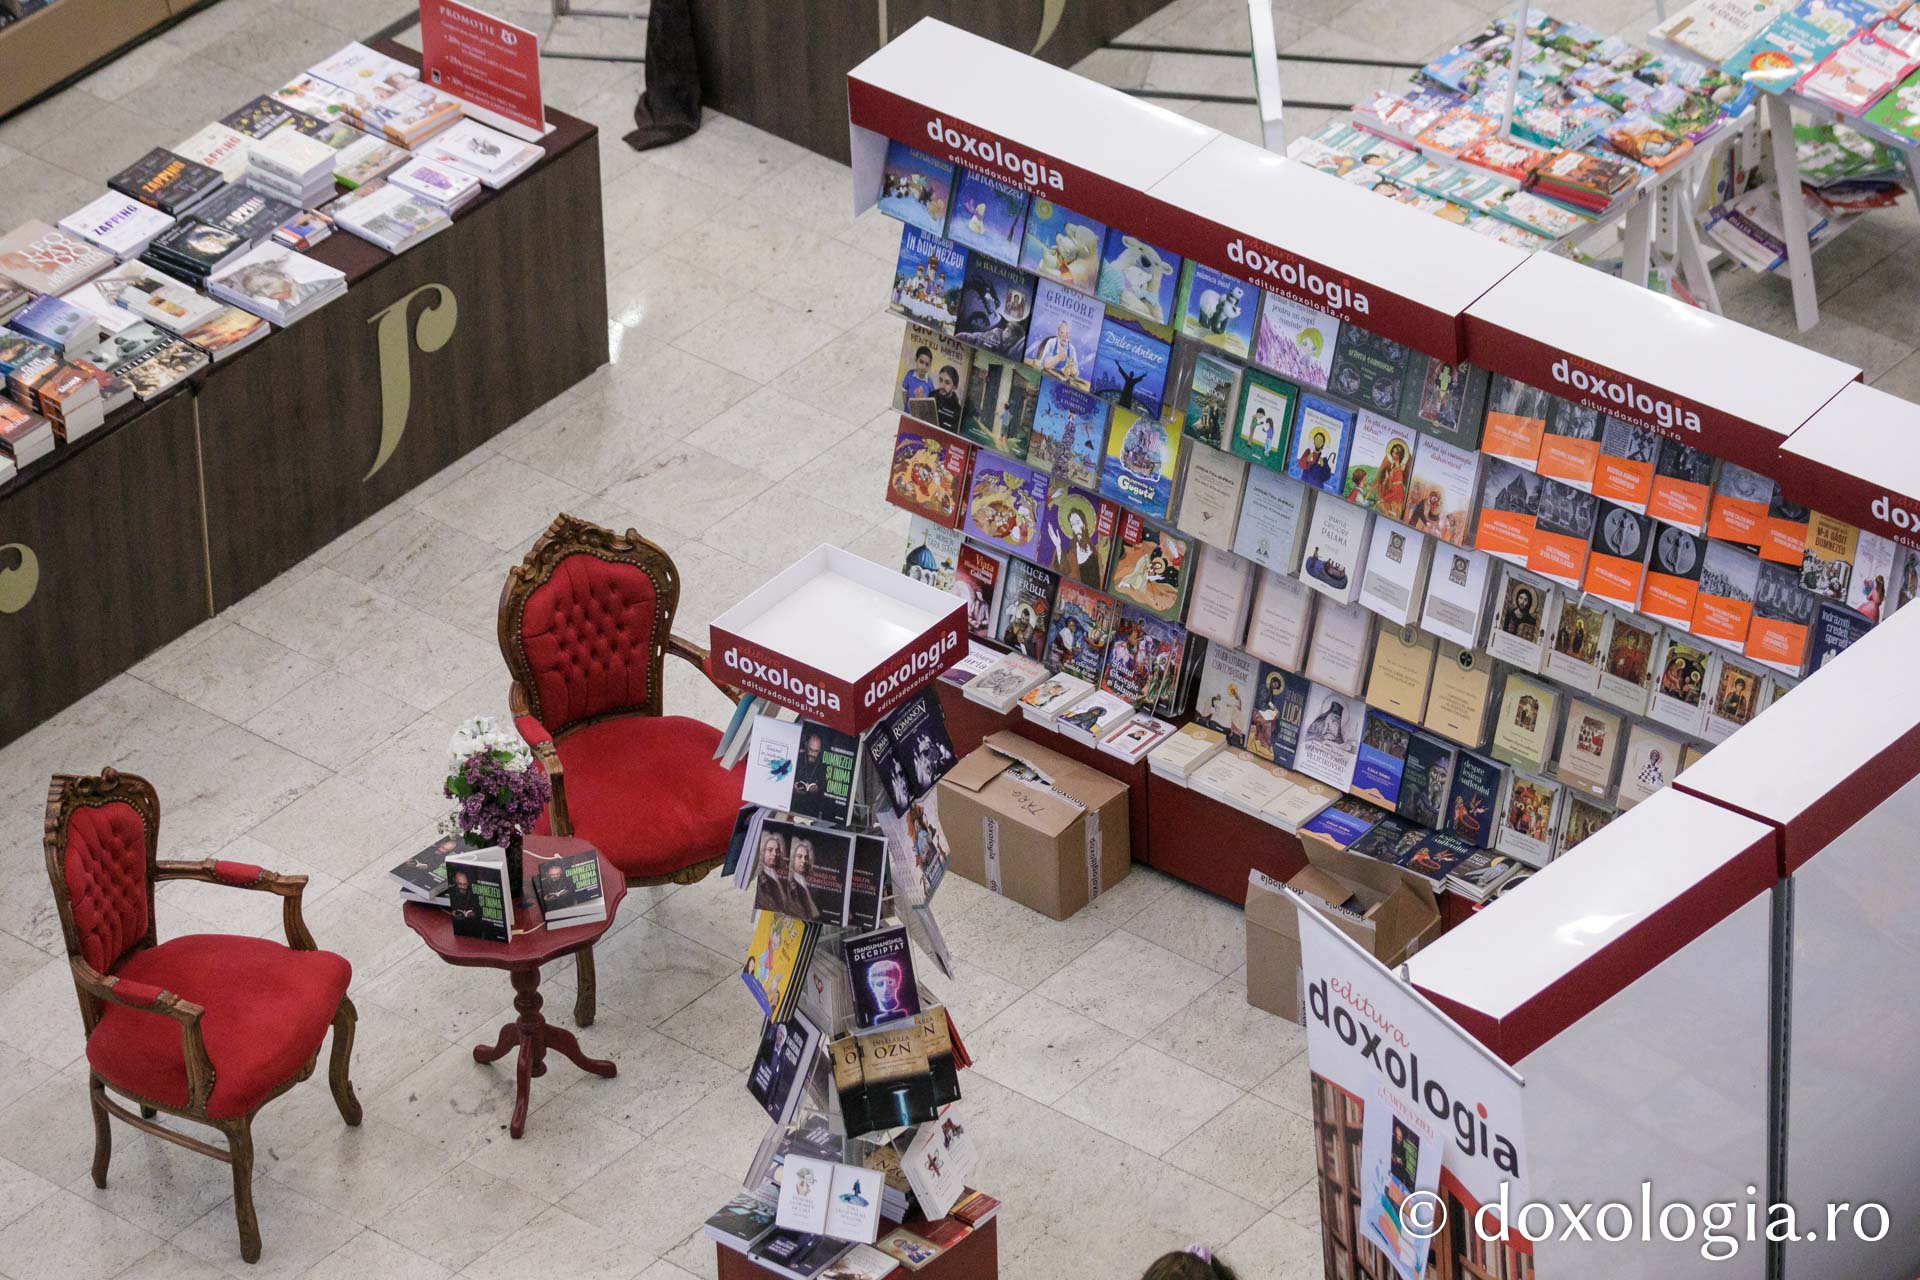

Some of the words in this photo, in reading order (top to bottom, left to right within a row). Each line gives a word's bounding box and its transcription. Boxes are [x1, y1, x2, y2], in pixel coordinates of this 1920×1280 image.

[203, 136, 241, 167] APPING
[927, 117, 1064, 191] doxologia
[142, 160, 186, 193] ZAPPING
[949, 153, 1046, 198] edituradoxologia.ro
[94, 204, 138, 236] ZAPPING
[1227, 239, 1369, 315] doxologia
[1046, 290, 1095, 319] GRIGORE
[1248, 276, 1350, 322] edituradoxologia.ro
[910, 334, 938, 351] PENTRU
[1552, 359, 1701, 433] doxologia
[1321, 528, 1348, 548] PALAMA
[1014, 560, 1050, 584] CRUCEA
[724, 647, 841, 712] doxologia
[864, 630, 957, 708] doxologia
[1109, 669, 1139, 692] Gheorghe
[741, 678, 825, 718] edituradoxologia.ro
[877, 662, 944, 713] edituradoxologia.ro
[893, 700, 926, 740] ROMANOV
[822, 751, 854, 770] DUMNEZEU
[1463, 759, 1485, 776] despre
[565, 862, 596, 878] DUMNEZEU
[853, 937, 903, 955] TRANSUMANISMUL
[854, 942, 905, 962] DECRIPTAT
[1330, 976, 1410, 1048] editura
[874, 1042, 912, 1060] OZN
[1308, 978, 1520, 1179] doxologia
